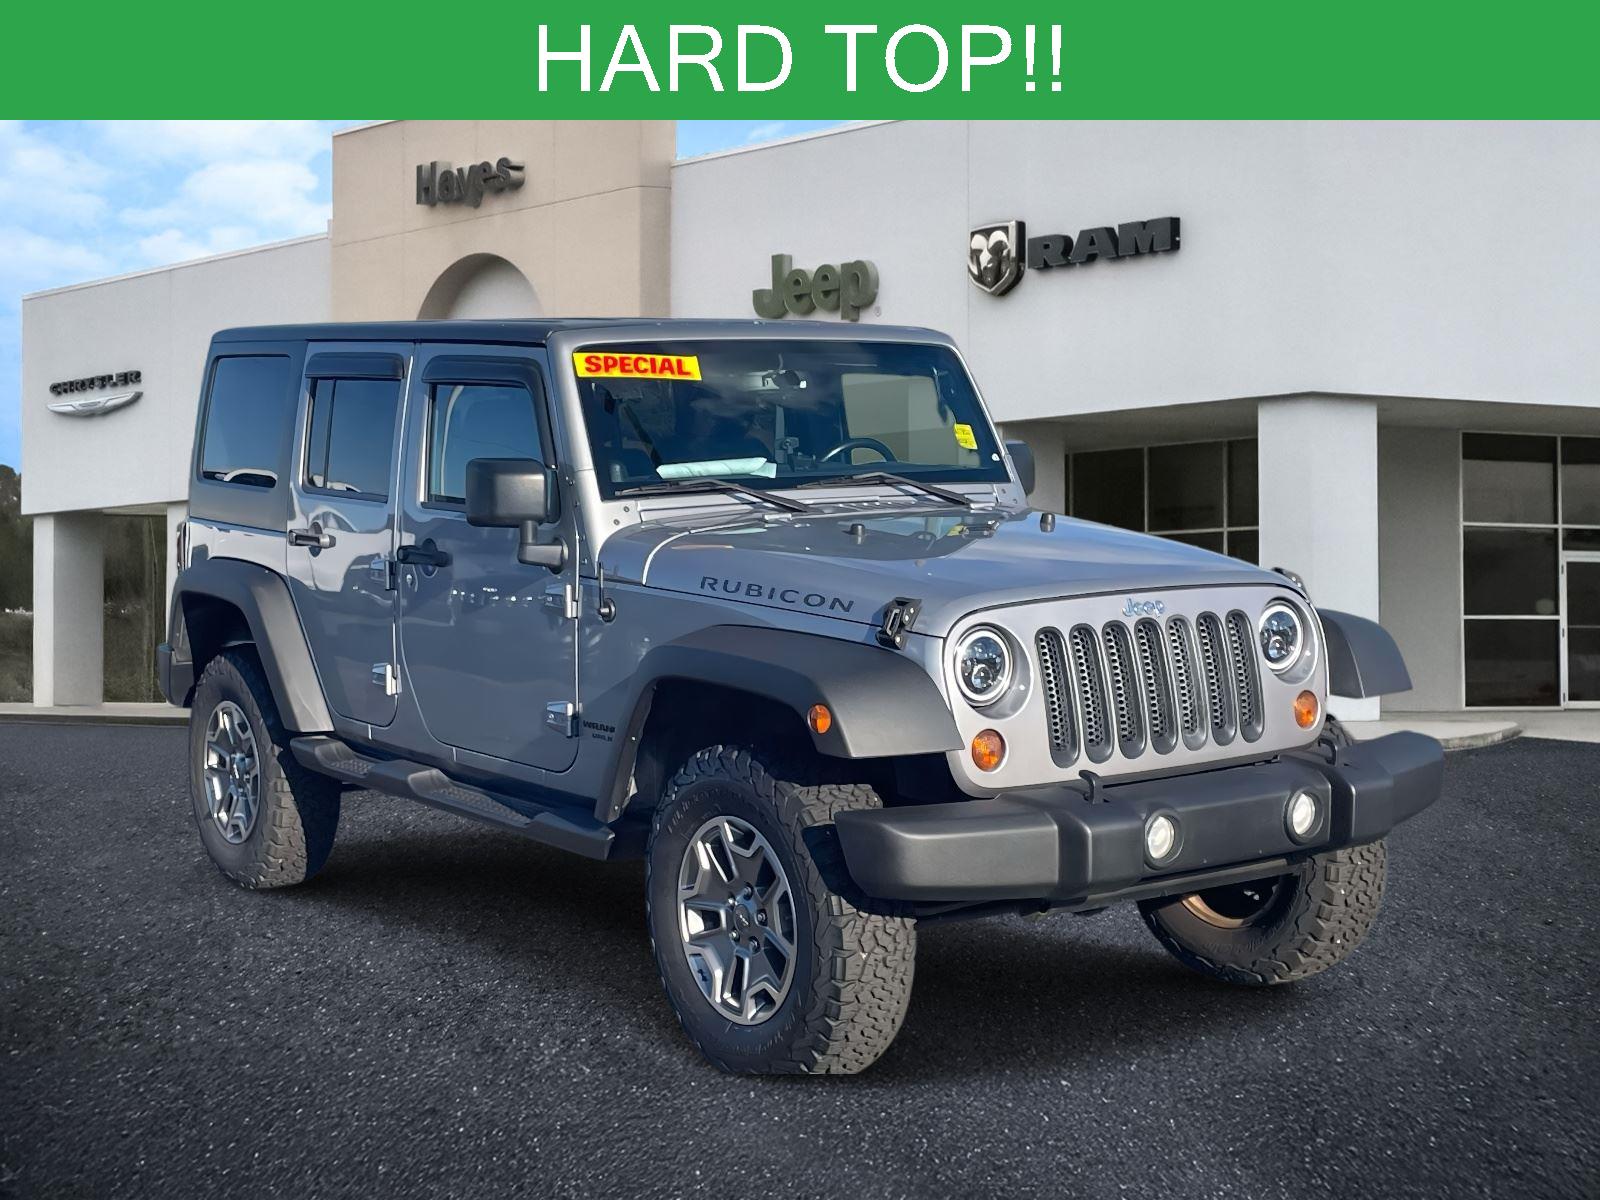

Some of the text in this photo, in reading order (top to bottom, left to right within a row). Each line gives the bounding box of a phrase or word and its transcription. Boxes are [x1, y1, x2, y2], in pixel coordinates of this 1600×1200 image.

[416, 157, 525, 209] Hayes
[1027, 216, 1181, 270] RAM
[752, 253, 879, 322] Jeep
[584, 355, 692, 377] SPECIAL
[700, 575, 855, 613] RUBICON
[1121, 598, 1165, 619] Jeep
